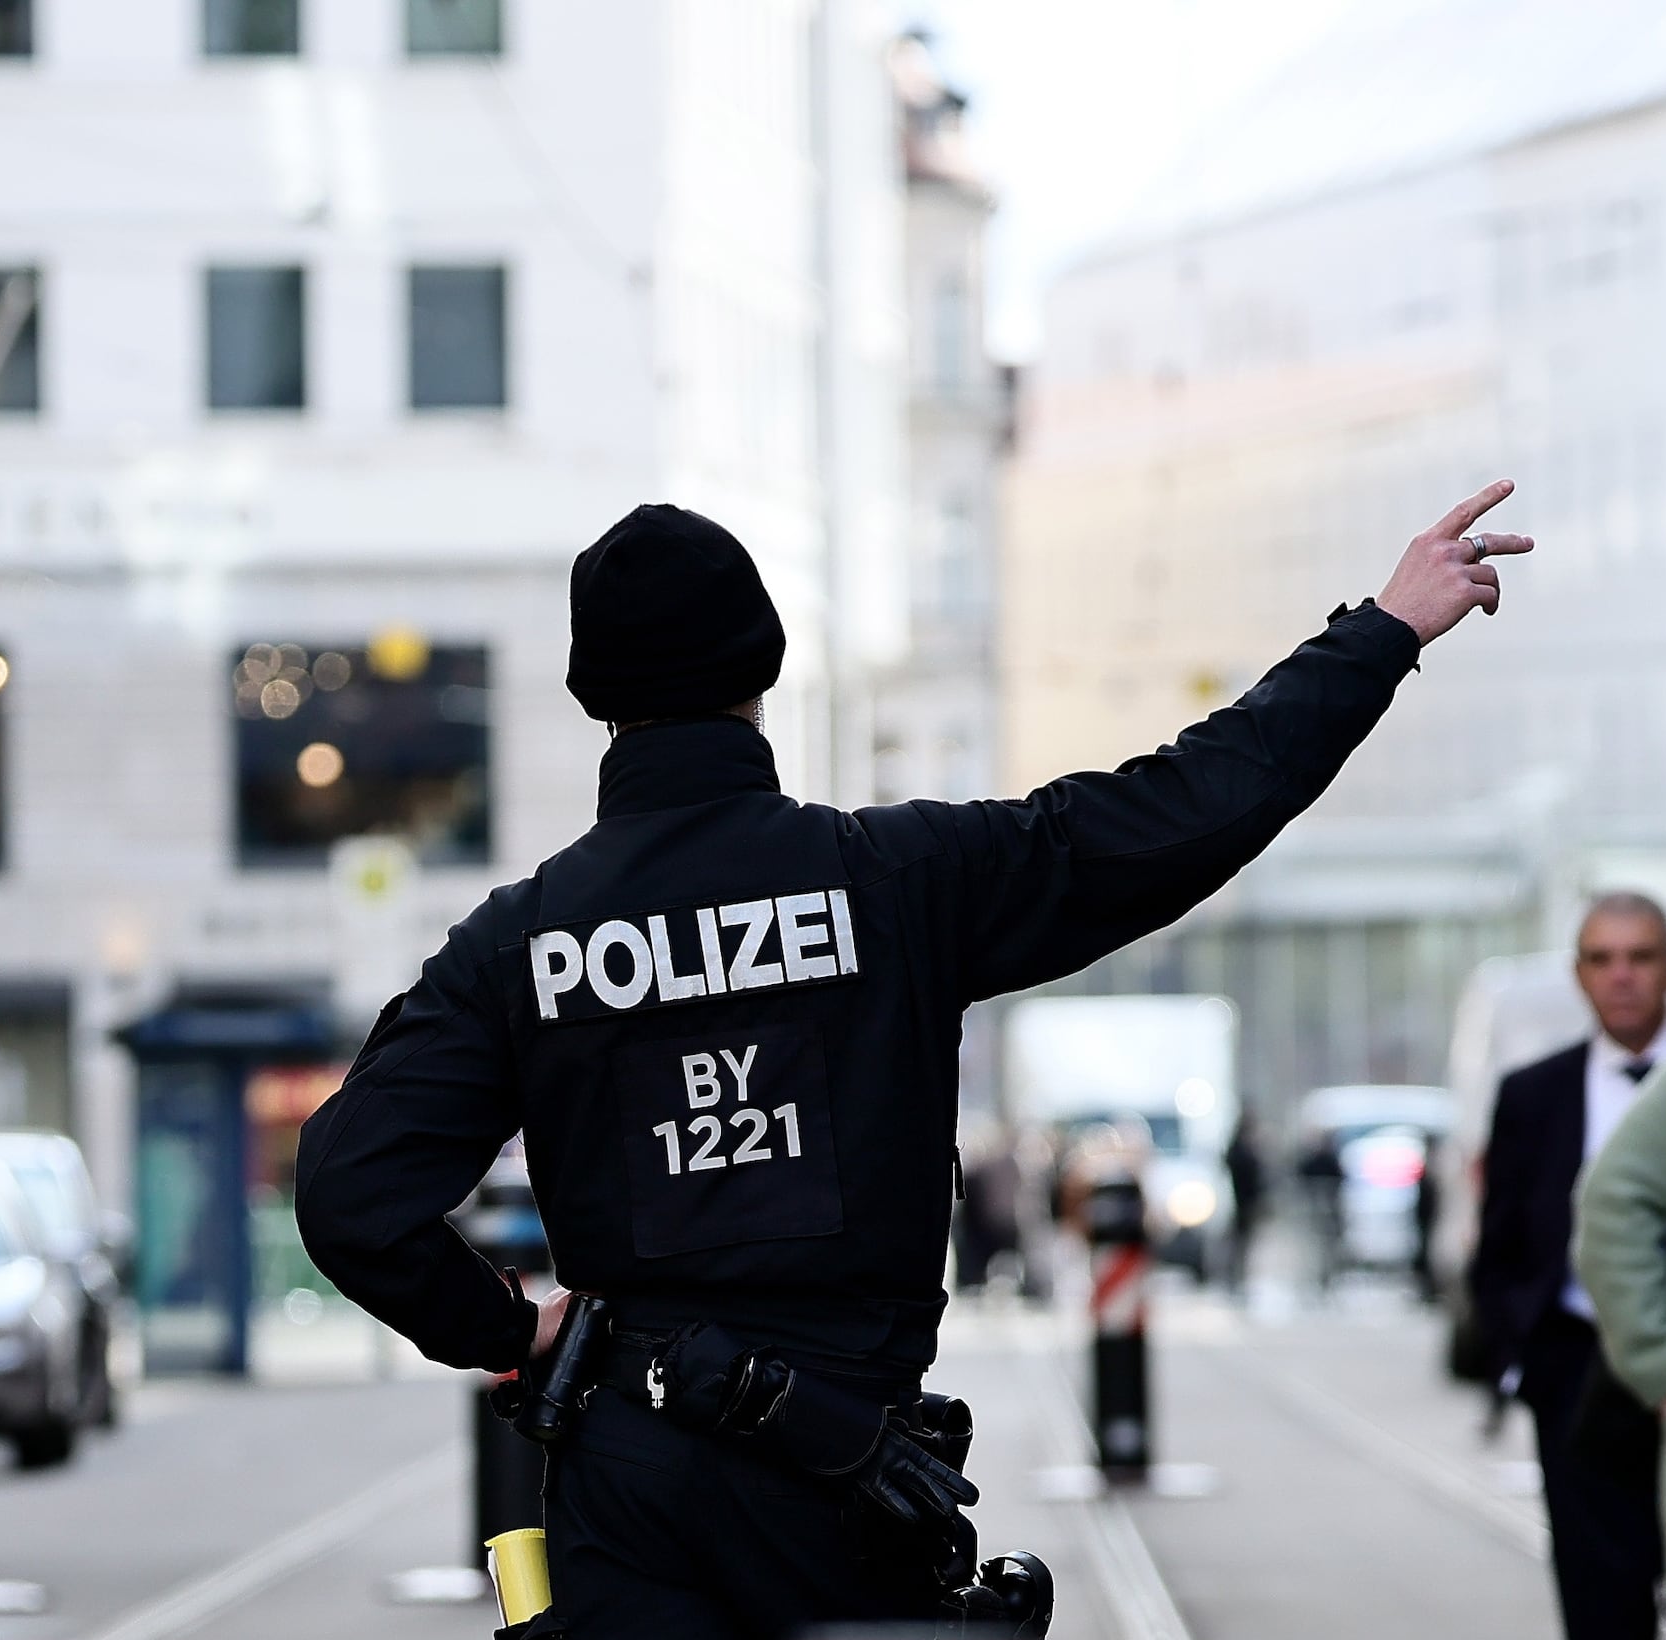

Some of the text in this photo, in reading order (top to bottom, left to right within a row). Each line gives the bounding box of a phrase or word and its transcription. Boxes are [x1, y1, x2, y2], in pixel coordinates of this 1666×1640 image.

[529, 888, 860, 1021] POLIZEI
[681, 1044, 759, 1110] BY
[652, 1102, 803, 1176] 1221
